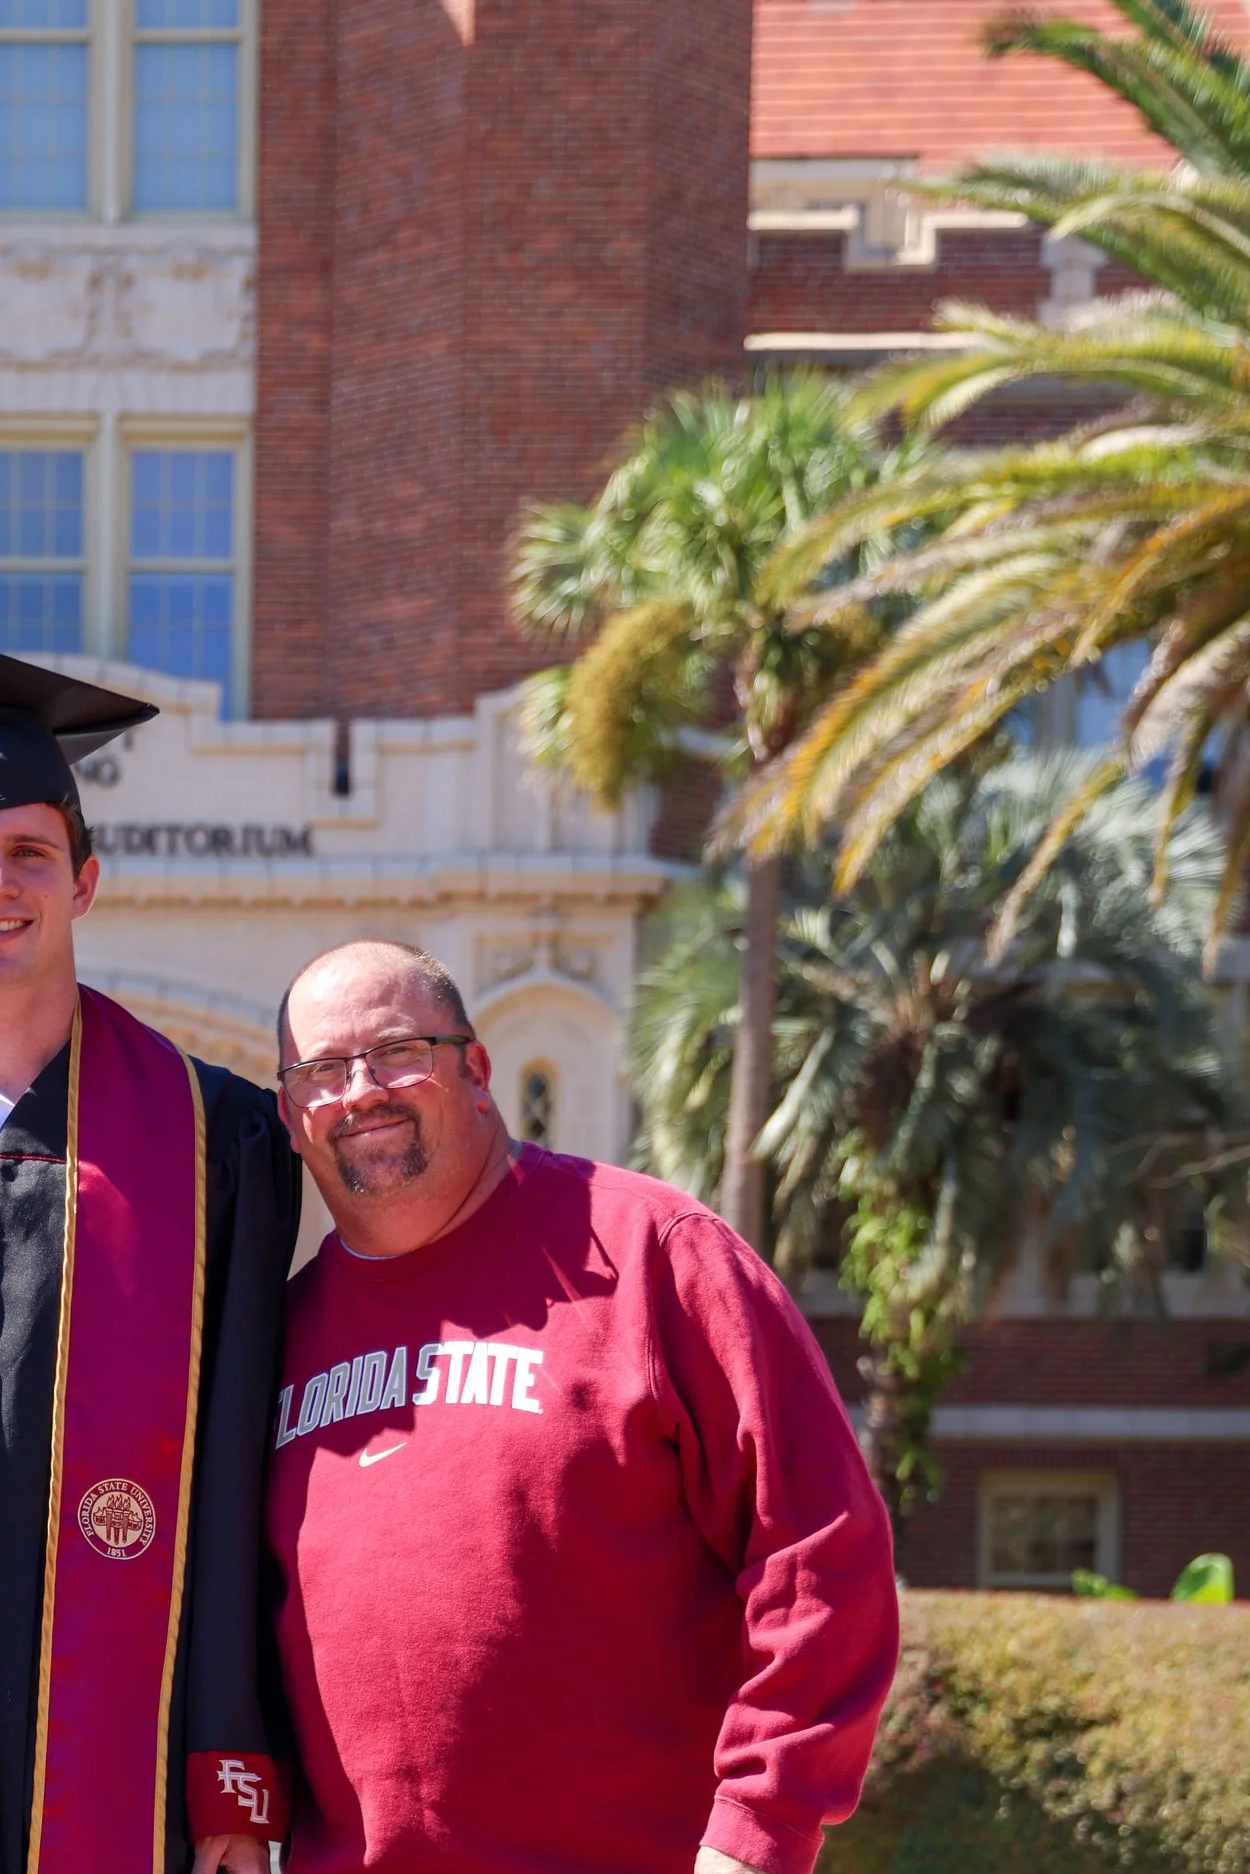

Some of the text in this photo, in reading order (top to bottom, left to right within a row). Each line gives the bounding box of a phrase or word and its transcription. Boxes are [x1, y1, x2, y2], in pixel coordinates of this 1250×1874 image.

[92, 821, 314, 856] UDITORIUM
[275, 1340, 544, 1450] LORIDA STATE
[81, 1481, 153, 1546] FLORIDA STATE UNIVERSITY
[106, 1546, 127, 1557] 1851
[216, 1758, 271, 1824] FSU
